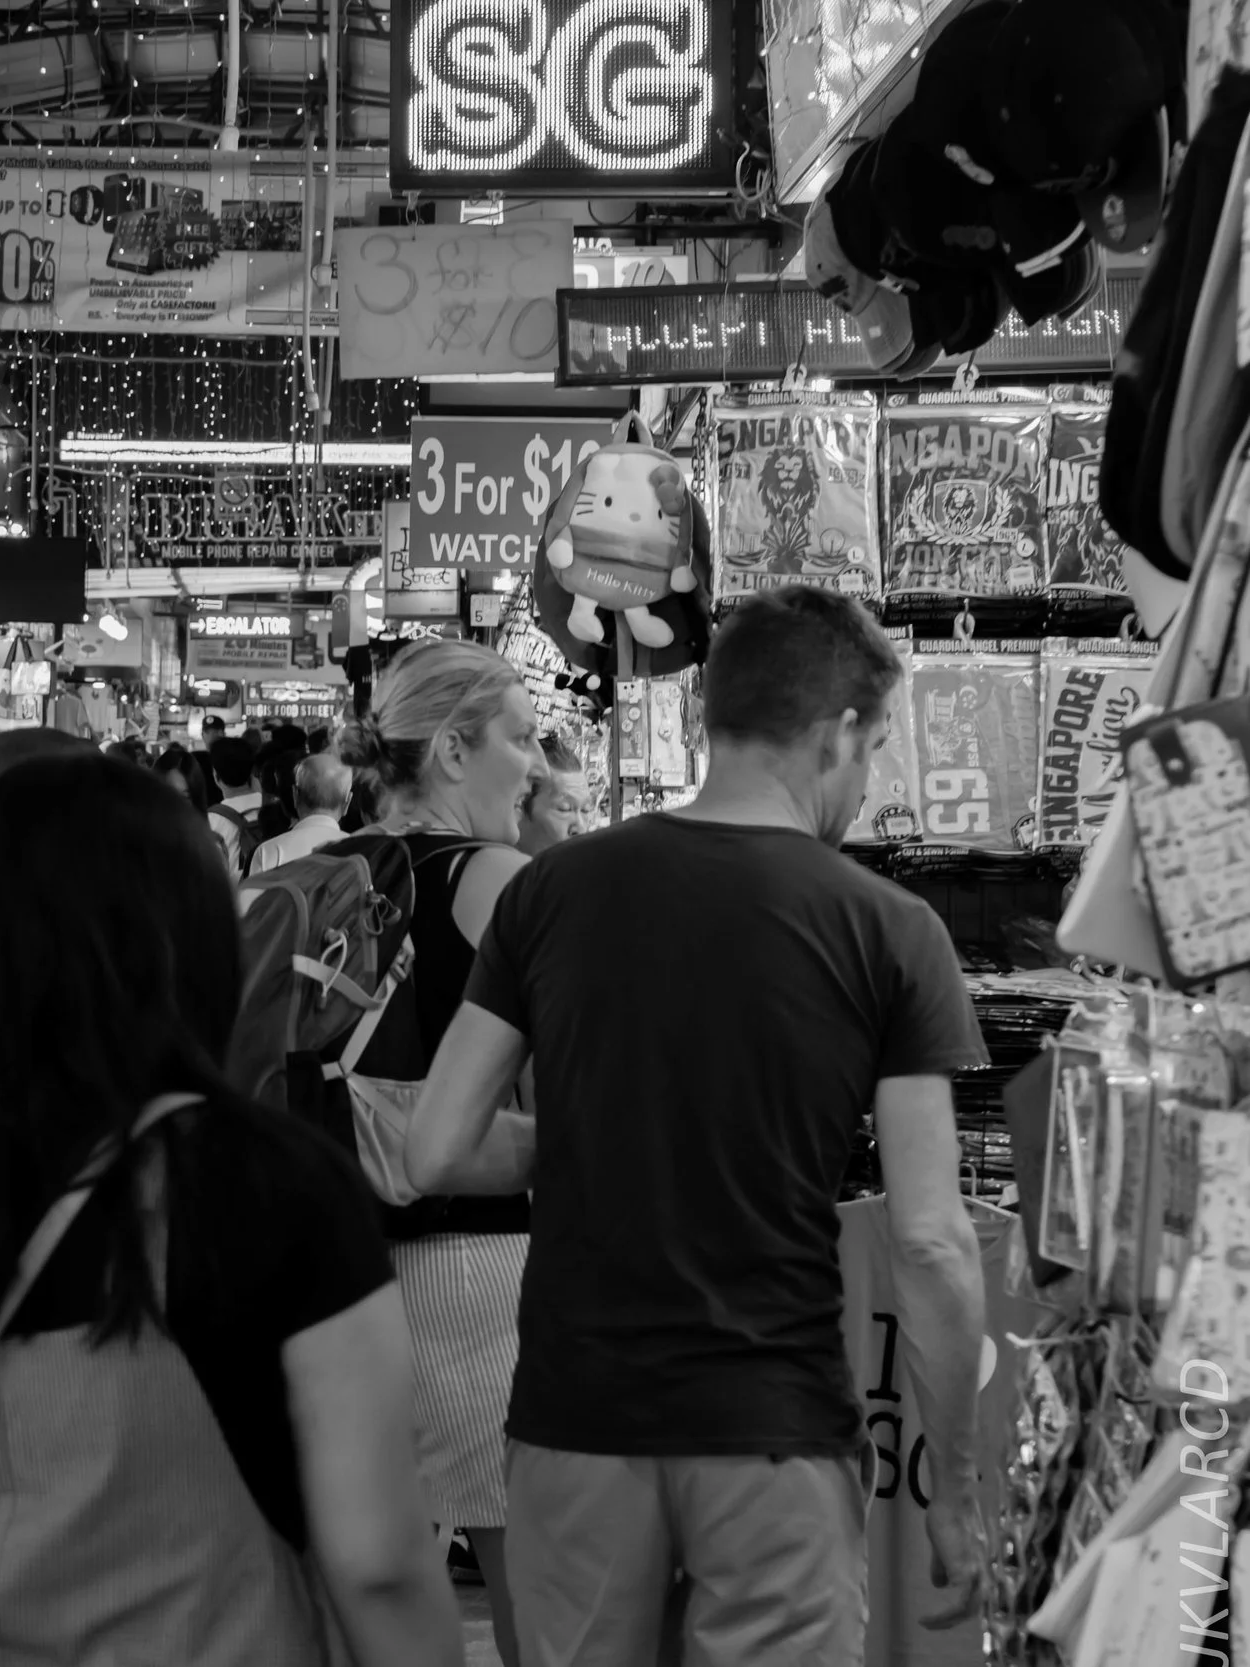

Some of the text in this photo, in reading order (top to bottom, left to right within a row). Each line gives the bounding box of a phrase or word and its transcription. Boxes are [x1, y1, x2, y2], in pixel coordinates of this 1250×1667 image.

[408, 0, 714, 171] SG
[19, 200, 42, 216] TO
[175, 224, 210, 237] FREE
[173, 241, 214, 254] GIFTS
[355, 233, 418, 315] 3
[31, 282, 55, 302] OFF
[429, 296, 558, 361] $10
[918, 391, 966, 405] GUARDIAN
[968, 389, 999, 404] ANGEL
[1083, 387, 1113, 403] GUAR
[417, 433, 600, 526] 3 For $1
[162, 545, 334, 559] MOBILE PHONE REPAIR CNTER
[401, 568, 450, 587] Street
[587, 566, 658, 599] Hello Kitty
[741, 574, 782, 589] LION
[474, 610, 483, 622] 5
[205, 616, 291, 635] ESCALATOR
[251, 639, 288, 650] Minutes
[919, 640, 967, 653] GUARDIAN
[969, 640, 999, 653] ANGEL
[1077, 641, 1159, 654] GUARDIAN ANGEL
[222, 650, 255, 658] MOBILE
[246, 704, 335, 718] BUGIS FOOD STREET
[1044, 668, 1107, 843] SINGAPORE
